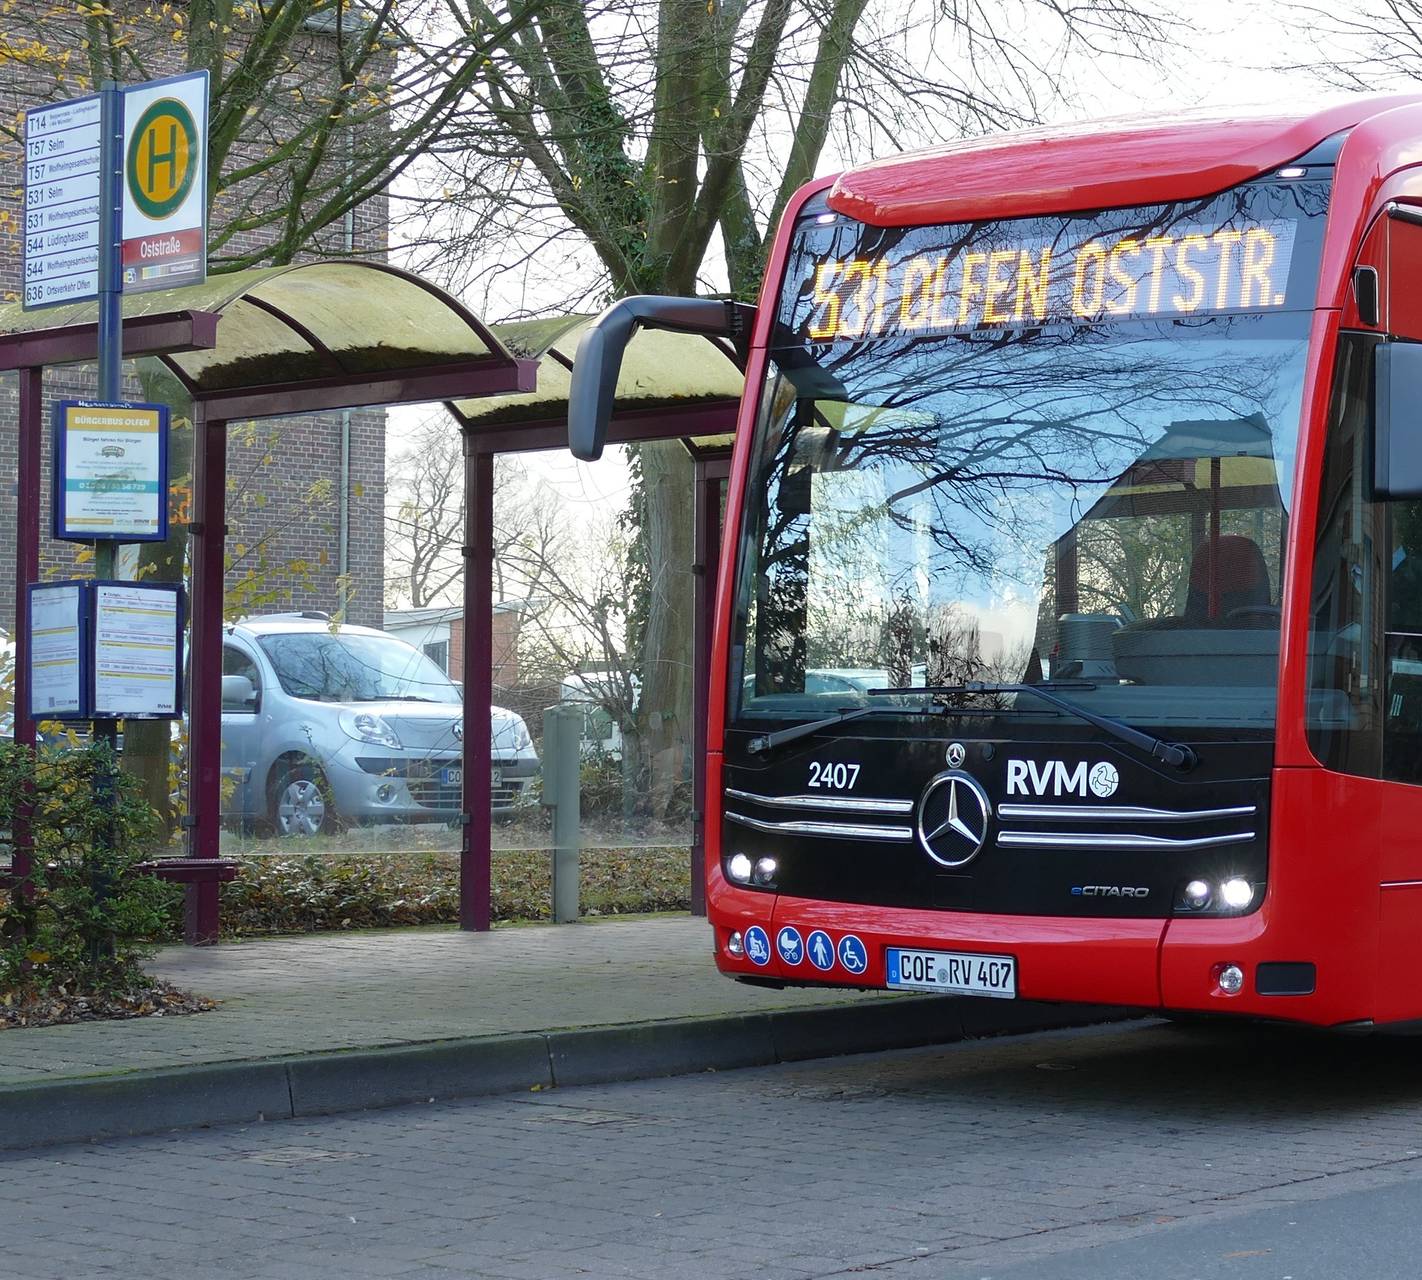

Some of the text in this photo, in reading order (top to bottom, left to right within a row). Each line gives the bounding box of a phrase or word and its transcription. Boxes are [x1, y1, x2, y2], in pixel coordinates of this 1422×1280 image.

[29, 114, 46, 132] T14
[28, 139, 65, 157] T57 Selm
[147, 124, 177, 193] H
[28, 164, 46, 181] T57
[28, 187, 64, 205] 531 Selm
[27, 213, 44, 229] 531
[27, 230, 89, 253] 544 Lüdinghausen
[140, 236, 181, 258] Oststraße
[26, 261, 43, 277] 544
[26, 285, 43, 301] 636
[47, 283, 76, 296] Ortsverkehr
[809, 228, 1286, 339] 531 OLFEN OSTSTR.
[74, 415, 151, 426] BÜRGERBUS OLFEN
[808, 761, 860, 790] 2407
[1071, 885, 1150, 897] eCITARO
[901, 955, 936, 983] COE
[949, 958, 972, 985] RV
[977, 961, 1012, 988] 407
